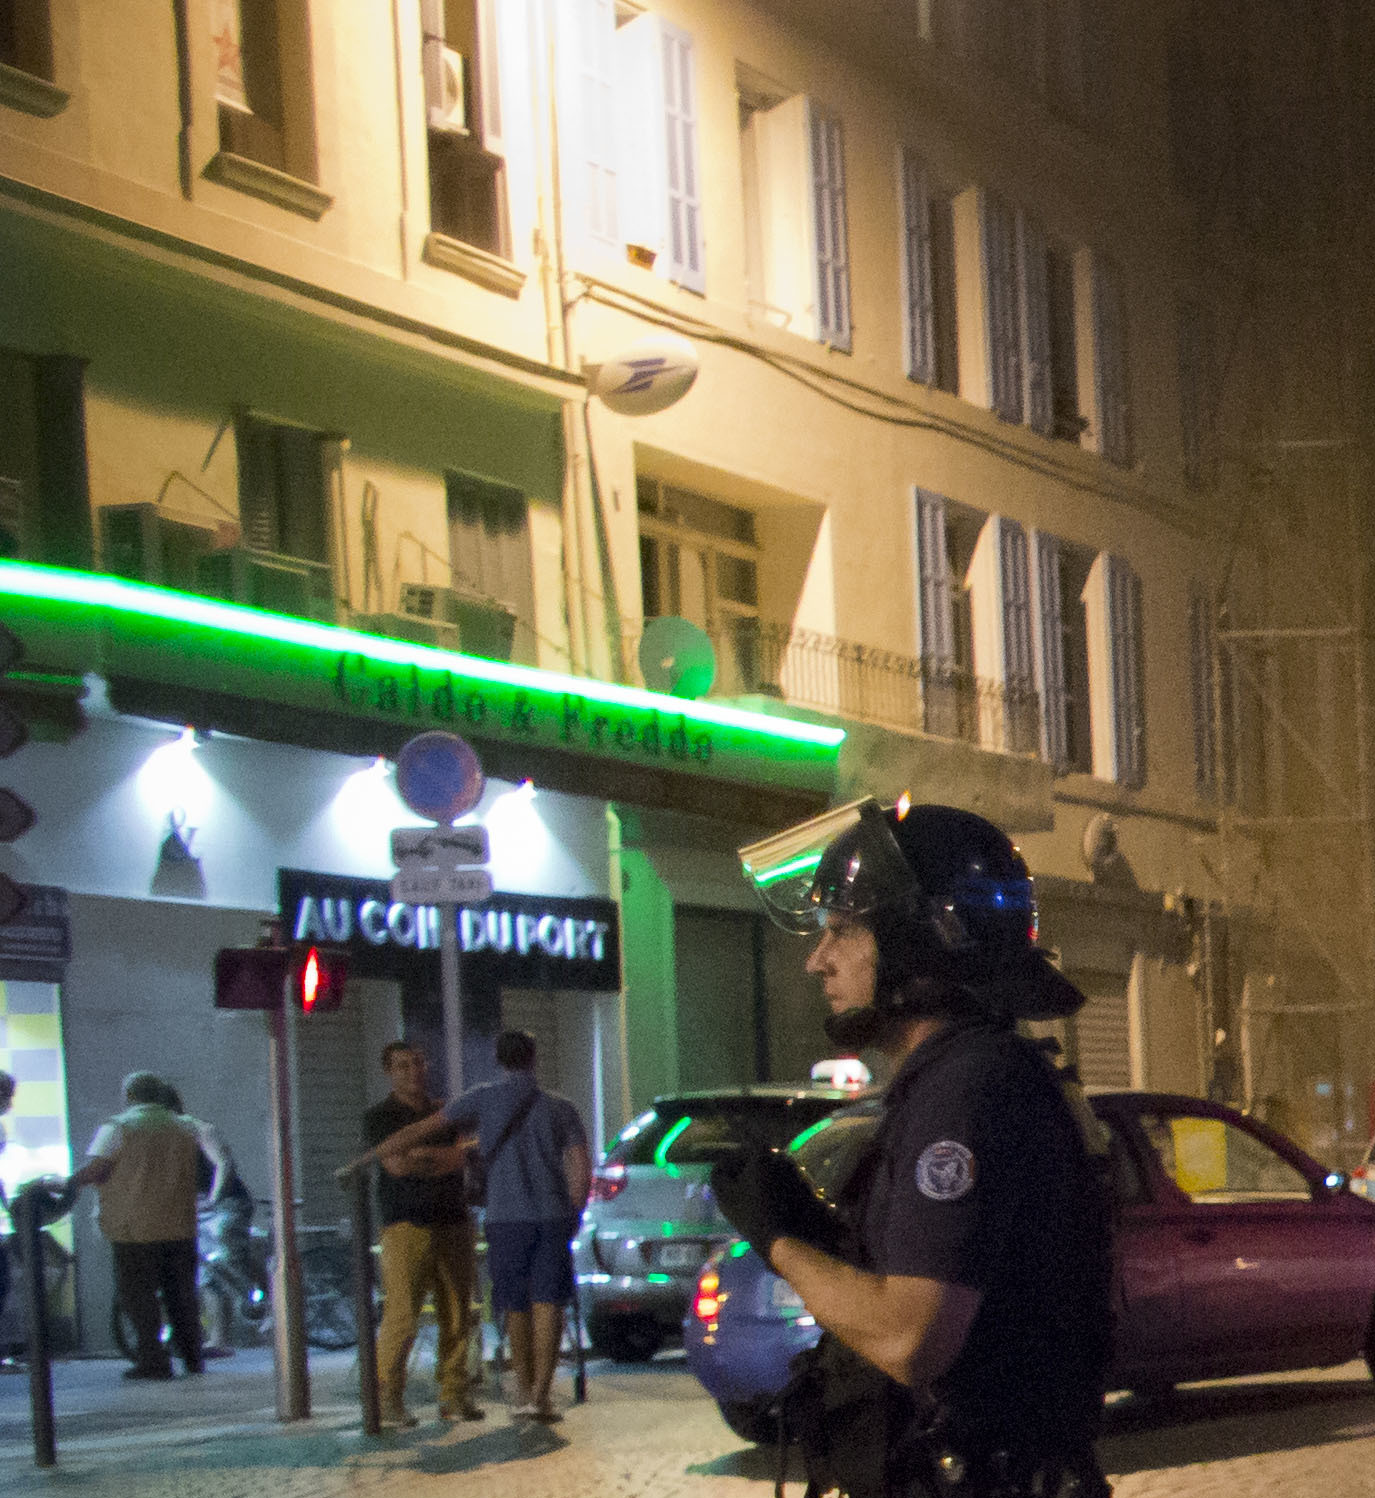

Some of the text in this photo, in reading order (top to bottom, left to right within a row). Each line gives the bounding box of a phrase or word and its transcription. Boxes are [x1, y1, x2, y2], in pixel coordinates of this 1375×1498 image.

[332, 652, 487, 726] Caldo
[294, 895, 352, 943] AU
[460, 907, 512, 953] DU
[516, 912, 609, 962] PORT
